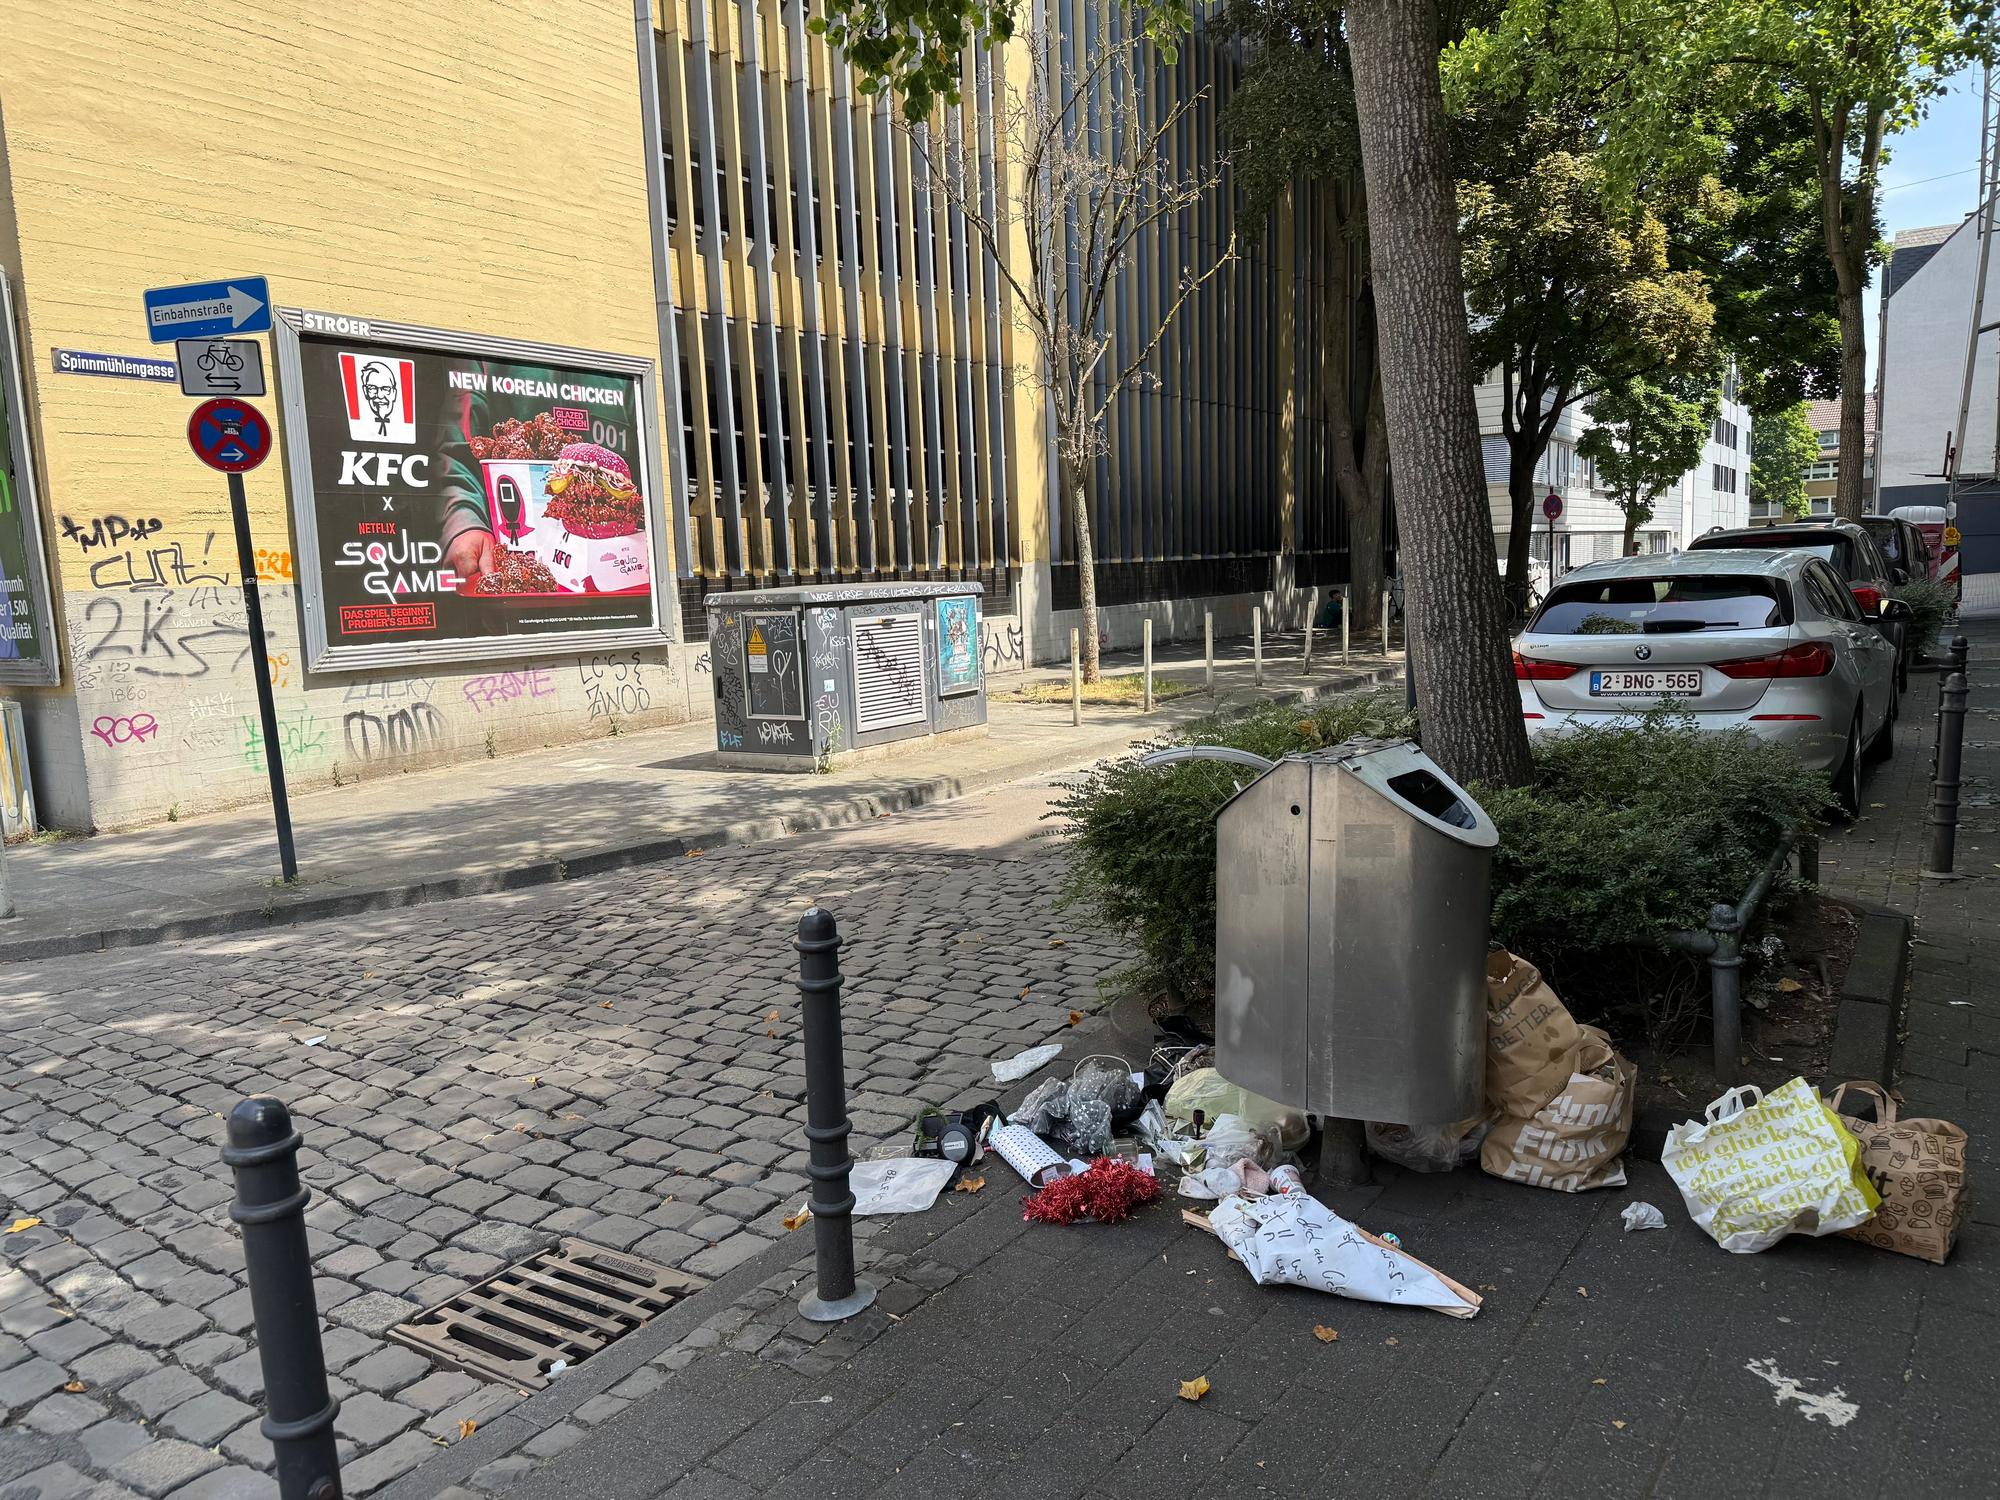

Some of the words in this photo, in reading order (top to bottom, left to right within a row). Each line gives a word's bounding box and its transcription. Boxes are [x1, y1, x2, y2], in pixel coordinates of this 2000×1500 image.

[153, 302, 233, 323] Einbahnstraße
[302, 313, 371, 336] STRÖER
[60, 354, 175, 379] Spinnmühlengasse
[448, 370, 488, 391] NEW
[491, 375, 559, 399] KOREAN
[560, 383, 624, 406] CHICKEN
[555, 409, 584, 421] GLAZED
[555, 417, 587, 429] CHICKEN
[592, 420, 627, 451] 001
[338, 451, 430, 488] KFC
[358, 522, 397, 535] NETFLIX
[334, 528, 442, 567] SQUID
[552, 548, 572, 569] KFC
[363, 568, 467, 605] GAME
[8, 599, 29, 616] 1.500
[344, 610, 365, 620] DAS
[364, 609, 391, 620] SPIEL
[390, 607, 432, 617] BEGINNT.
[0, 622, 33, 641] Qualität
[347, 617, 397, 630] PROBIER'S
[396, 616, 432, 627] SELBST.
[1713, 1125, 1790, 1161] glück
[1760, 1136, 1838, 1170] glück
